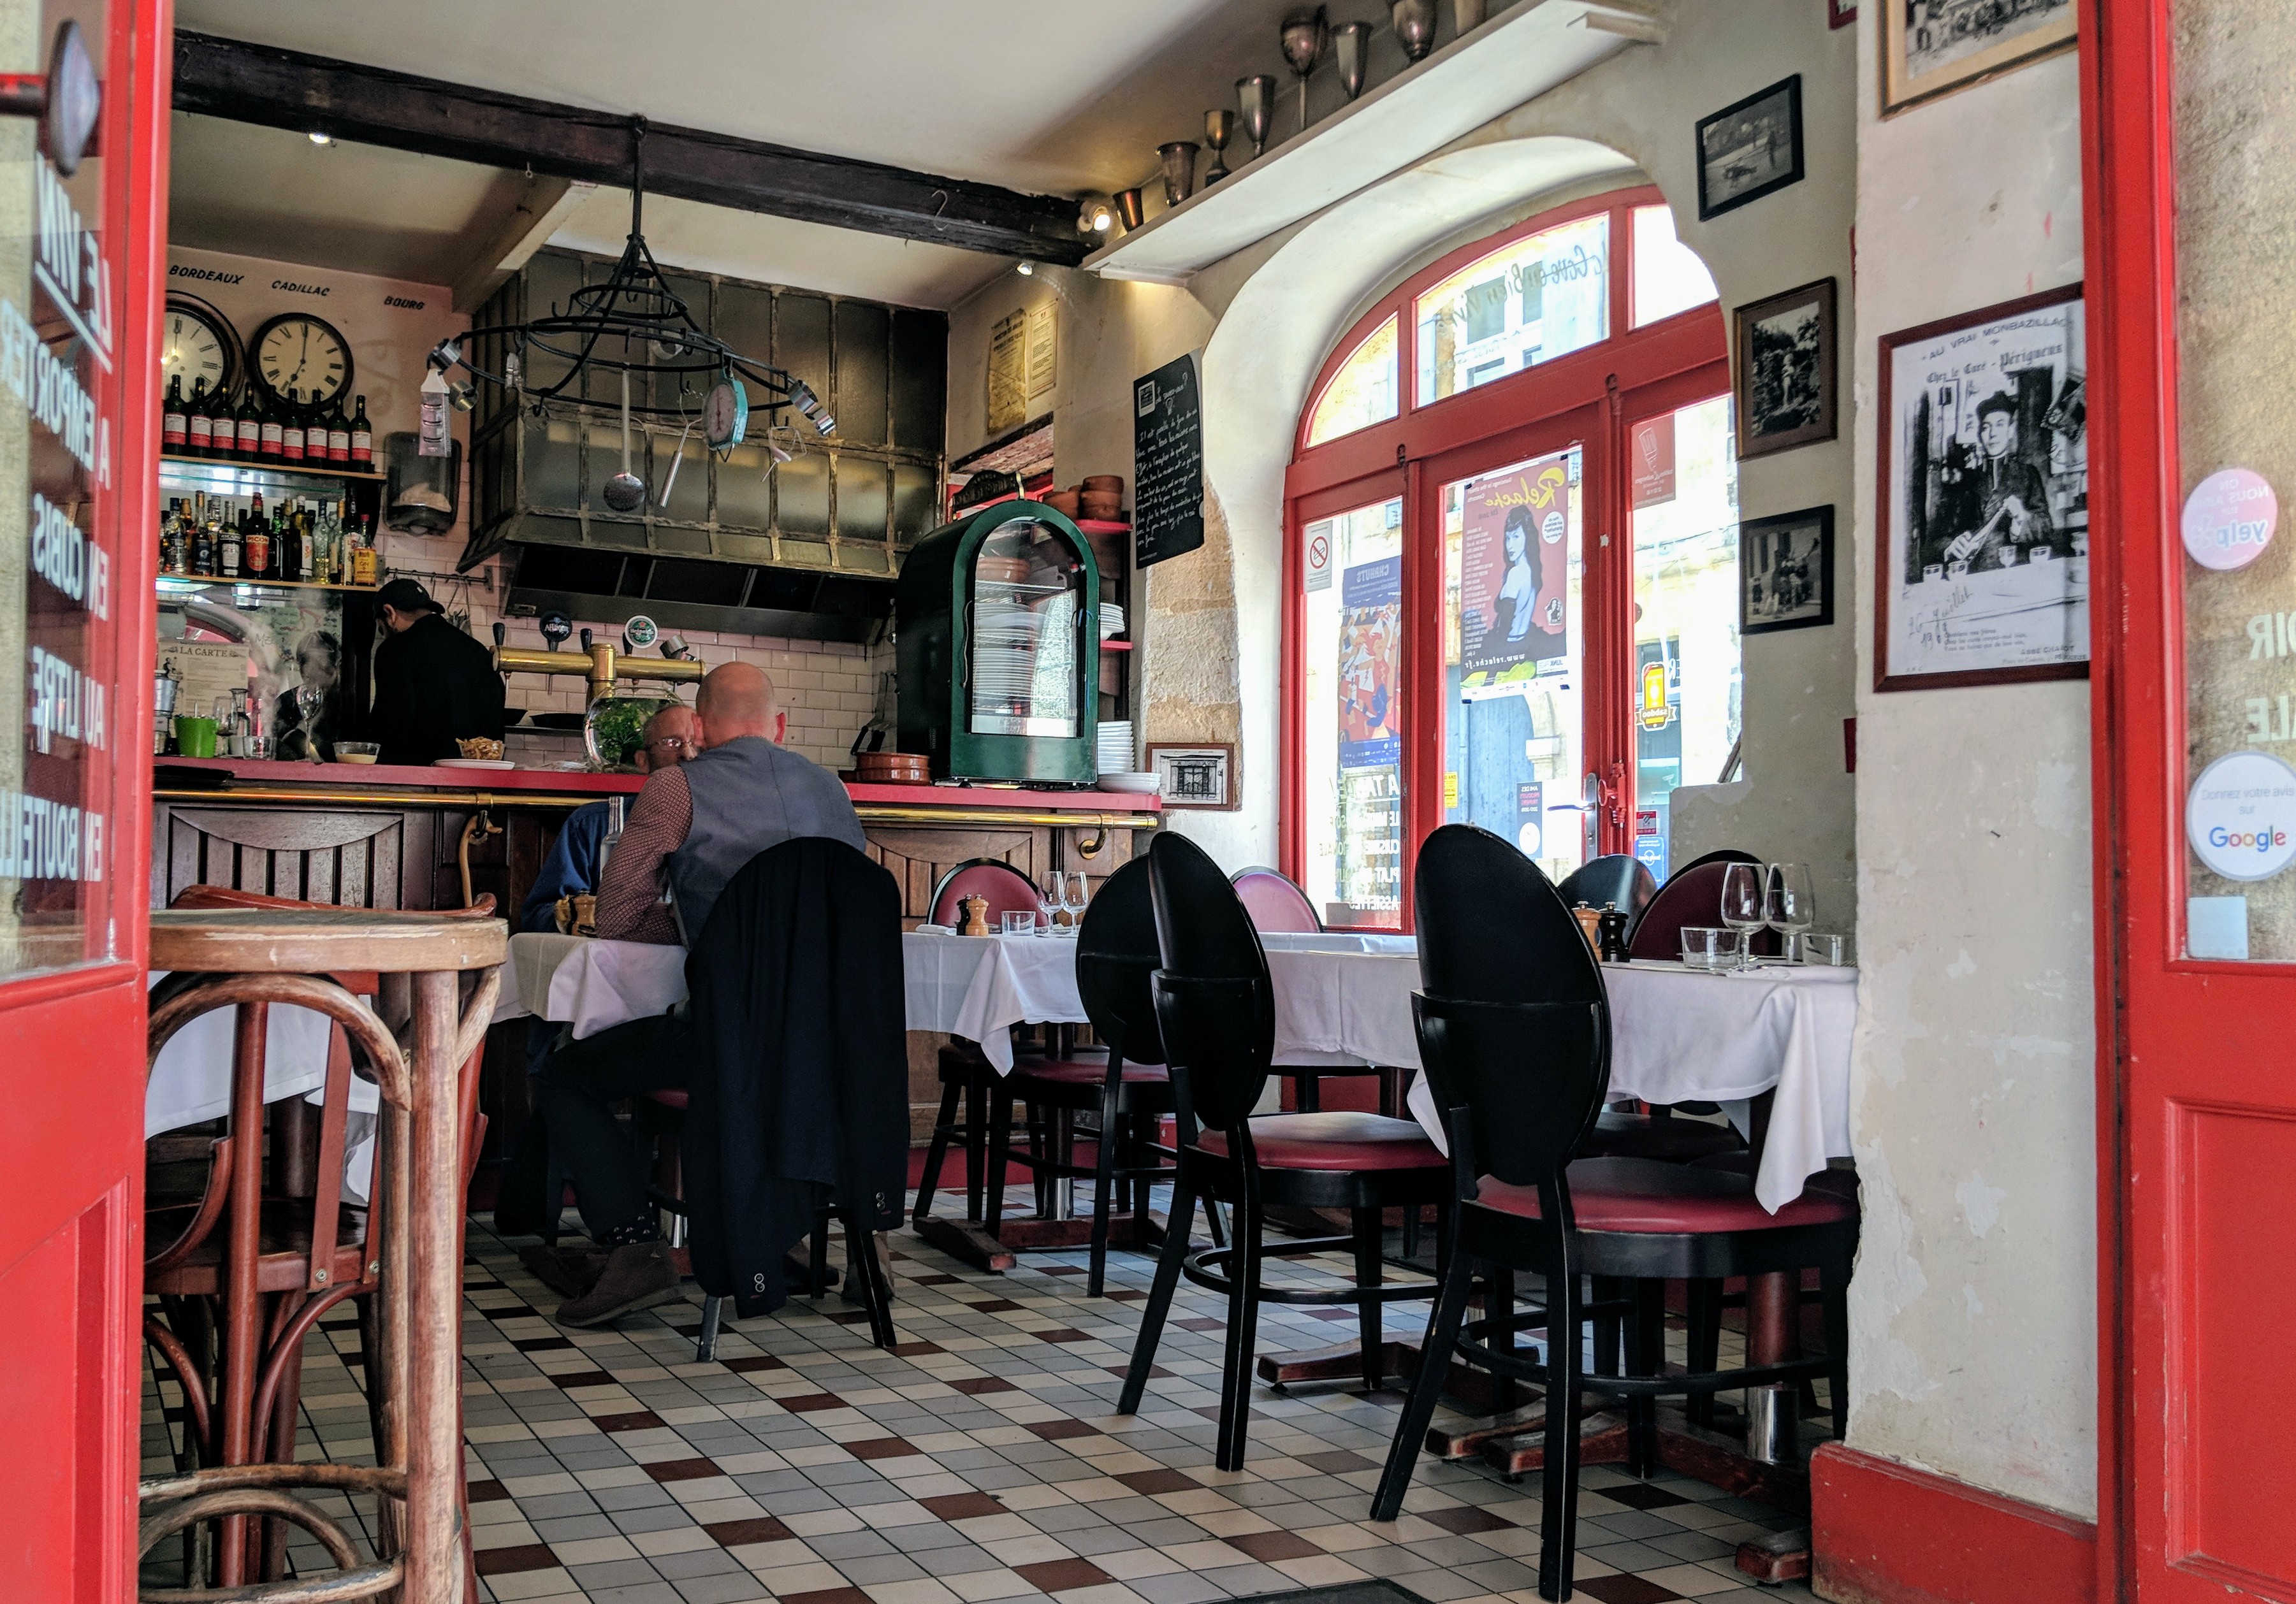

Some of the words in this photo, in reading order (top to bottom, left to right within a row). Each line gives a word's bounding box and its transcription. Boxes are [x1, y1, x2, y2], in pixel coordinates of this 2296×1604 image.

[169, 265, 245, 285] BORDEAUX
[271, 280, 330, 297] CADILLAC
[383, 296, 425, 310] BOURG
[1929, 345, 1945, 360] AU
[1951, 333, 1977, 349] VRAI
[179, 646, 194, 656] LA
[195, 647, 228, 657] CARTE
[2244, 787, 2271, 798] votre
[2272, 783, 2295, 797] avis
[2239, 806, 2255, 815] sur
[2209, 825, 2286, 853] Google
